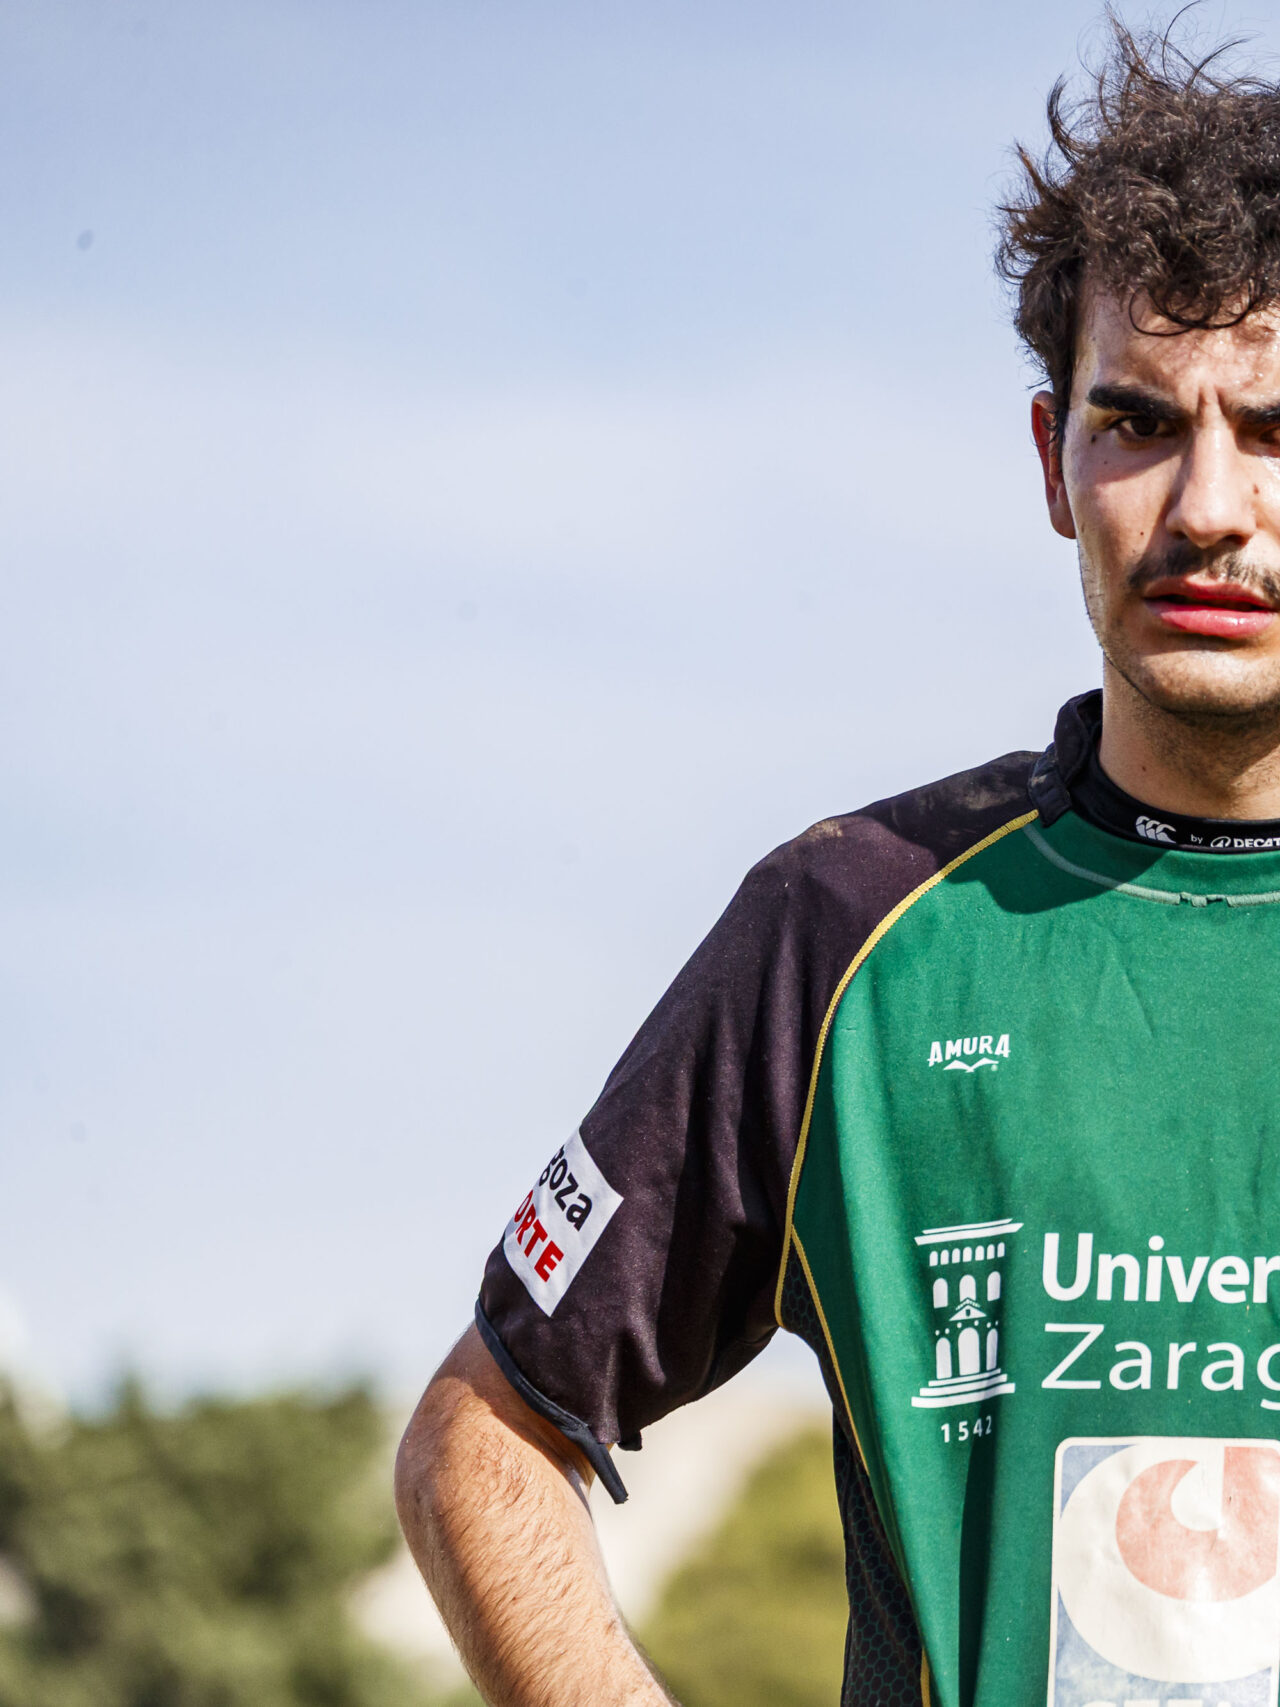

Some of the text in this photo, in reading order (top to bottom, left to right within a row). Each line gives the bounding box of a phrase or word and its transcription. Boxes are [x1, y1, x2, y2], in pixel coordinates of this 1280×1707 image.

[1191, 834, 1203, 844] by
[927, 1033, 1011, 1067] AMURA
[941, 1415, 992, 1443] 1542
